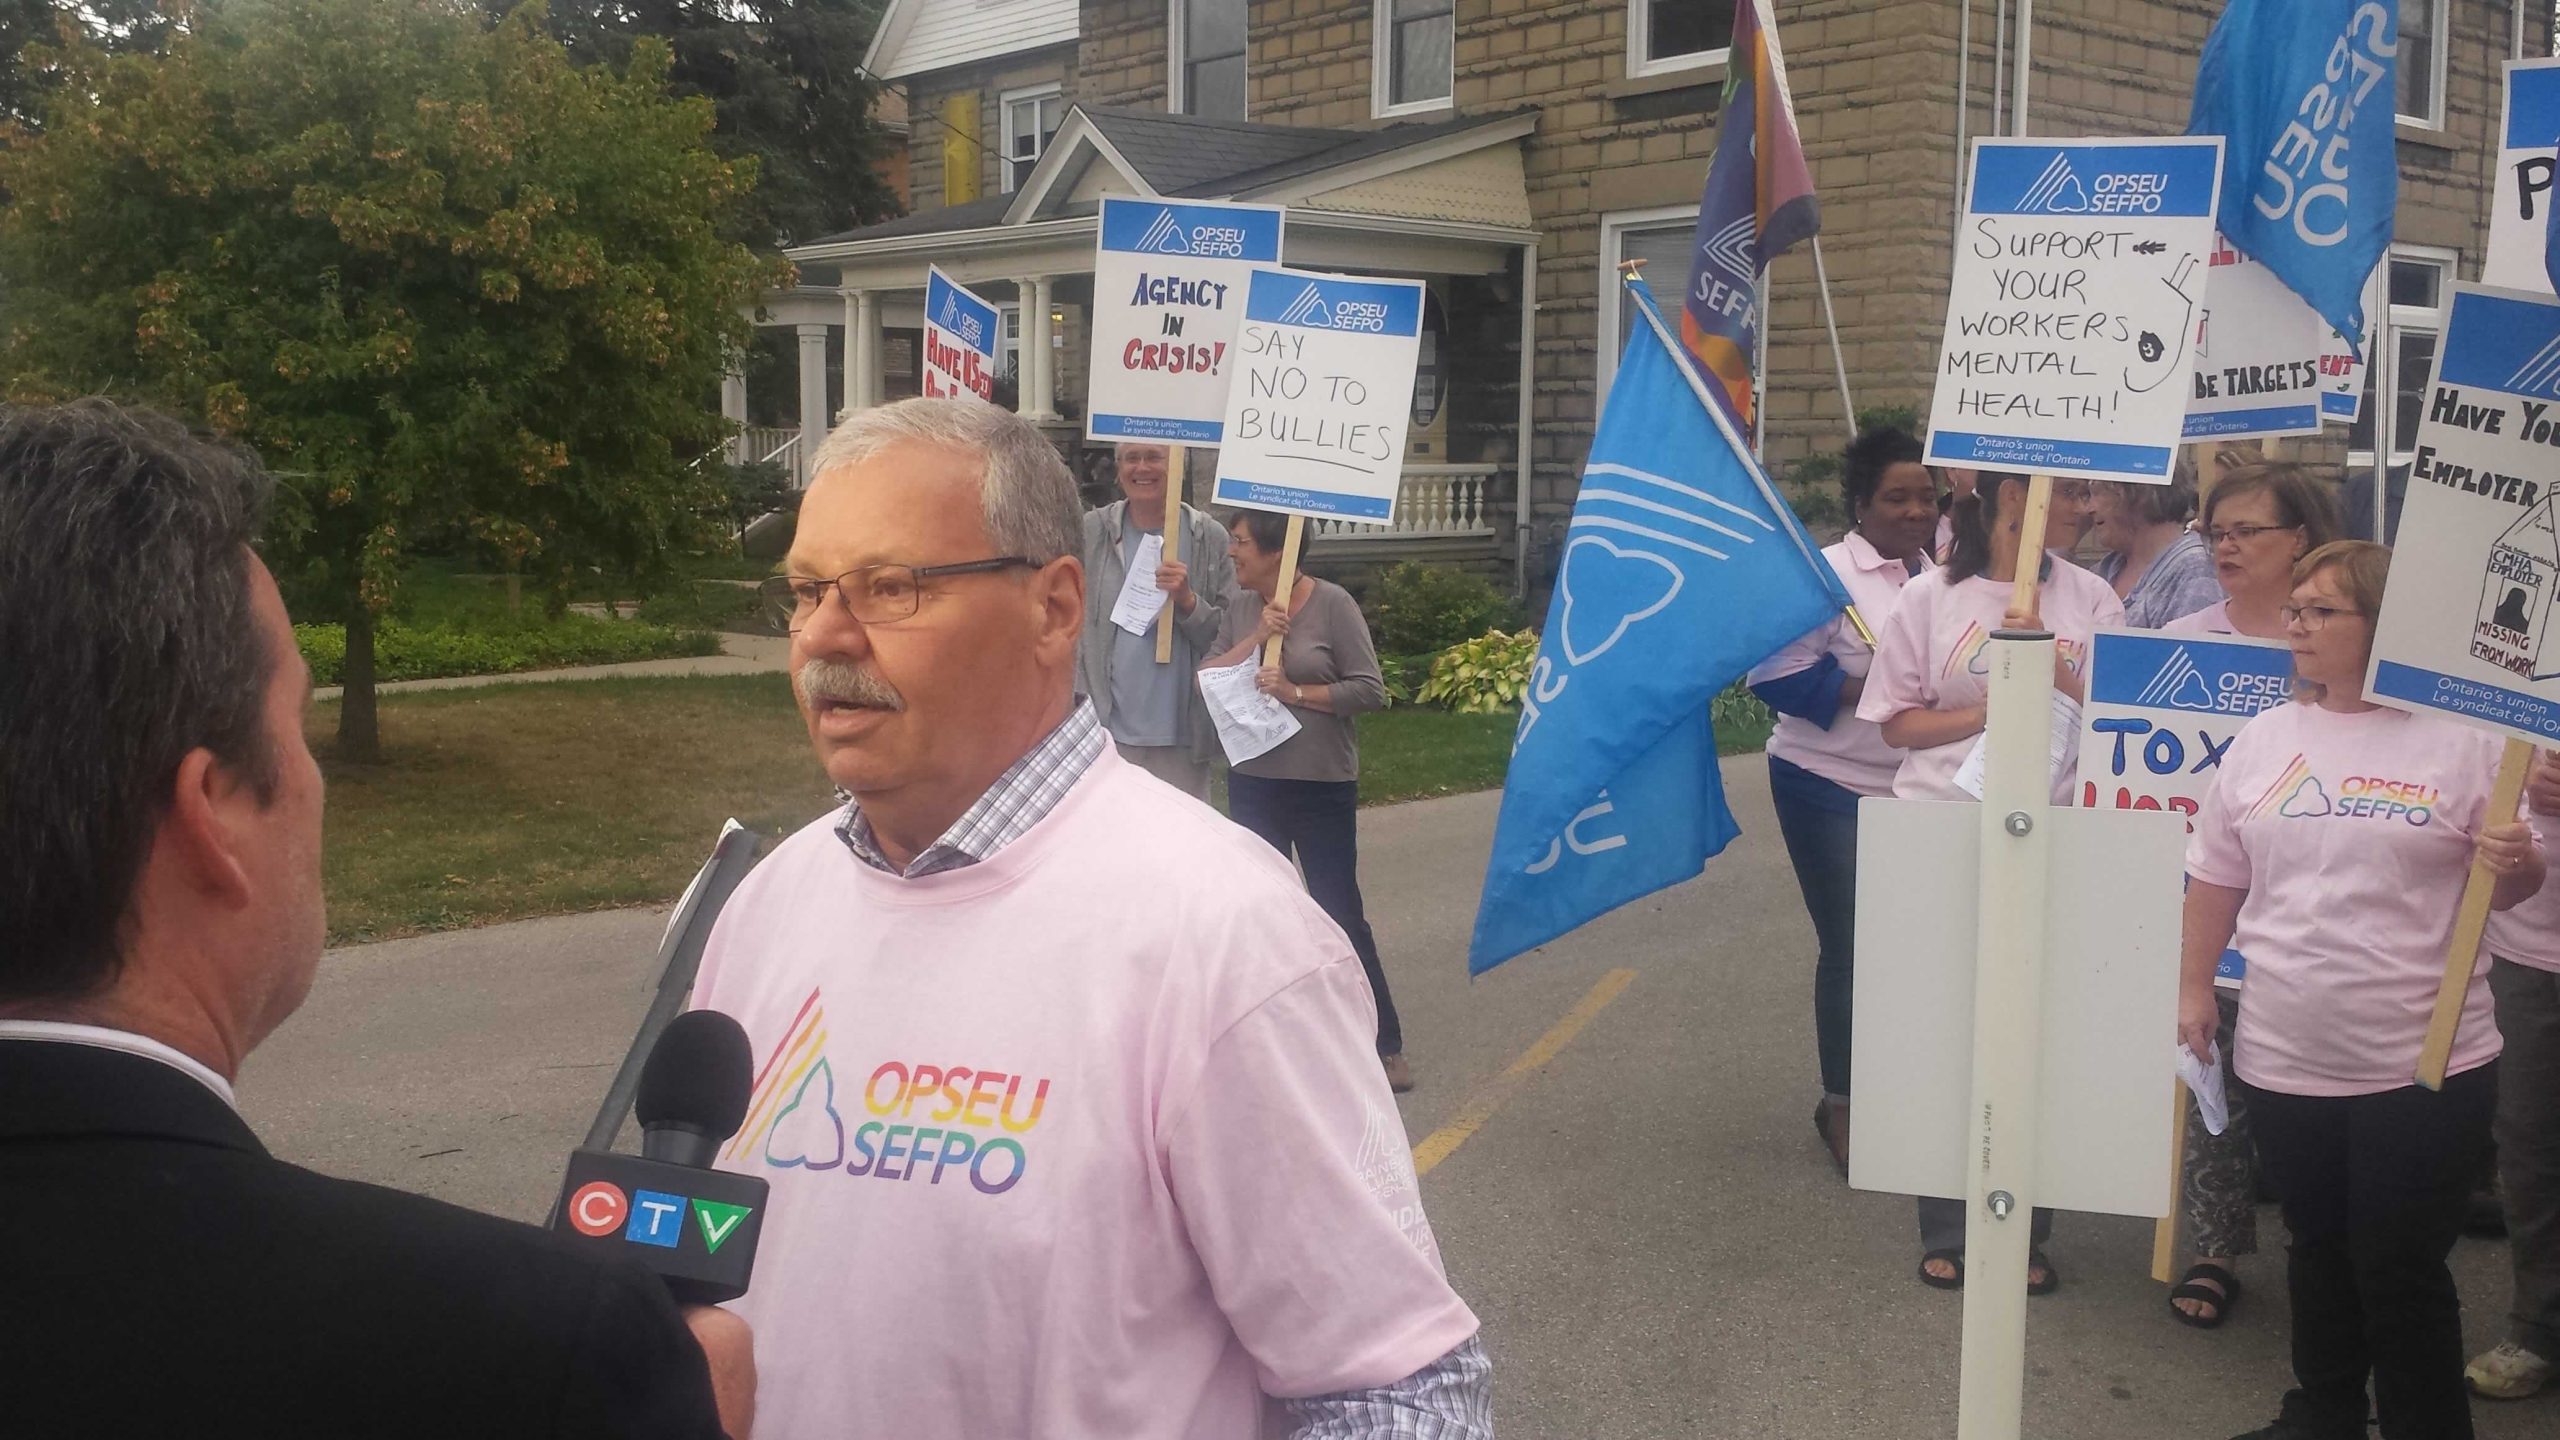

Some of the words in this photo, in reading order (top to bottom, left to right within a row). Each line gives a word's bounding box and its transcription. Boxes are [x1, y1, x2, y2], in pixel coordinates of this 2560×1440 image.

[2094, 174, 2168, 194] OPSEU
[2089, 194, 2162, 213] SEFPO
[1190, 241, 1242, 257] SEFPO
[1192, 226, 1246, 243] OPSEU
[1974, 218, 2134, 260] SUPPORT
[1129, 272, 1228, 310] AGENCY
[1993, 268, 2087, 305] YOUR
[962, 312, 983, 335] OPSEU
[1333, 315, 1384, 332] SEFPO
[1335, 301, 1388, 317] OPSEU
[960, 326, 981, 347] SEFPO
[1161, 312, 1185, 338] IN
[1961, 310, 2129, 342] WORKERS
[927, 327, 961, 381] HAVE
[1123, 337, 1226, 376] CRISIS!
[1241, 326, 1304, 360] SAY
[1947, 350, 2097, 378] MENTAL
[2223, 359, 2316, 397] TARGETS
[1251, 366, 1307, 400] NO
[1323, 376, 1366, 406] TO
[1958, 388, 2119, 424] HEALTH!
[2430, 387, 2506, 435] HAVE
[1124, 417, 1159, 428] Ontario's
[1161, 420, 1182, 429] union
[1133, 427, 1164, 437] syndicat
[1165, 428, 1175, 436] de
[1236, 408, 1392, 461] BULLIES
[1972, 448, 1985, 458] Le
[1987, 449, 2028, 463] syndicat
[2030, 452, 2044, 462] de
[2046, 452, 2090, 466] l'Ontario
[1975, 436, 2023, 449] Ontario's
[2025, 440, 2054, 452] union
[2414, 445, 2538, 507] EMPLOYER
[1251, 484, 1286, 496] Ontario's
[1287, 489, 1310, 499] union
[1259, 495, 1291, 505] syndicat
[2492, 550, 2533, 573] CMHA
[2477, 621, 2531, 651] MISSING
[2473, 641, 2505, 664] FROM
[2505, 653, 2536, 678] WORK
[2218, 672, 2294, 696] OPSEU
[2437, 677, 2503, 703] Ontario's
[2507, 695, 2548, 715] union
[2432, 690, 2450, 704] Le
[2452, 696, 2511, 720] syndicat
[2514, 711, 2533, 725] de
[2340, 776, 2439, 805] OPSEU
[2334, 797, 2432, 827] SEFPO
[865, 1061, 1050, 1134] OPSEU
[846, 1121, 1026, 1195] SEFPO
